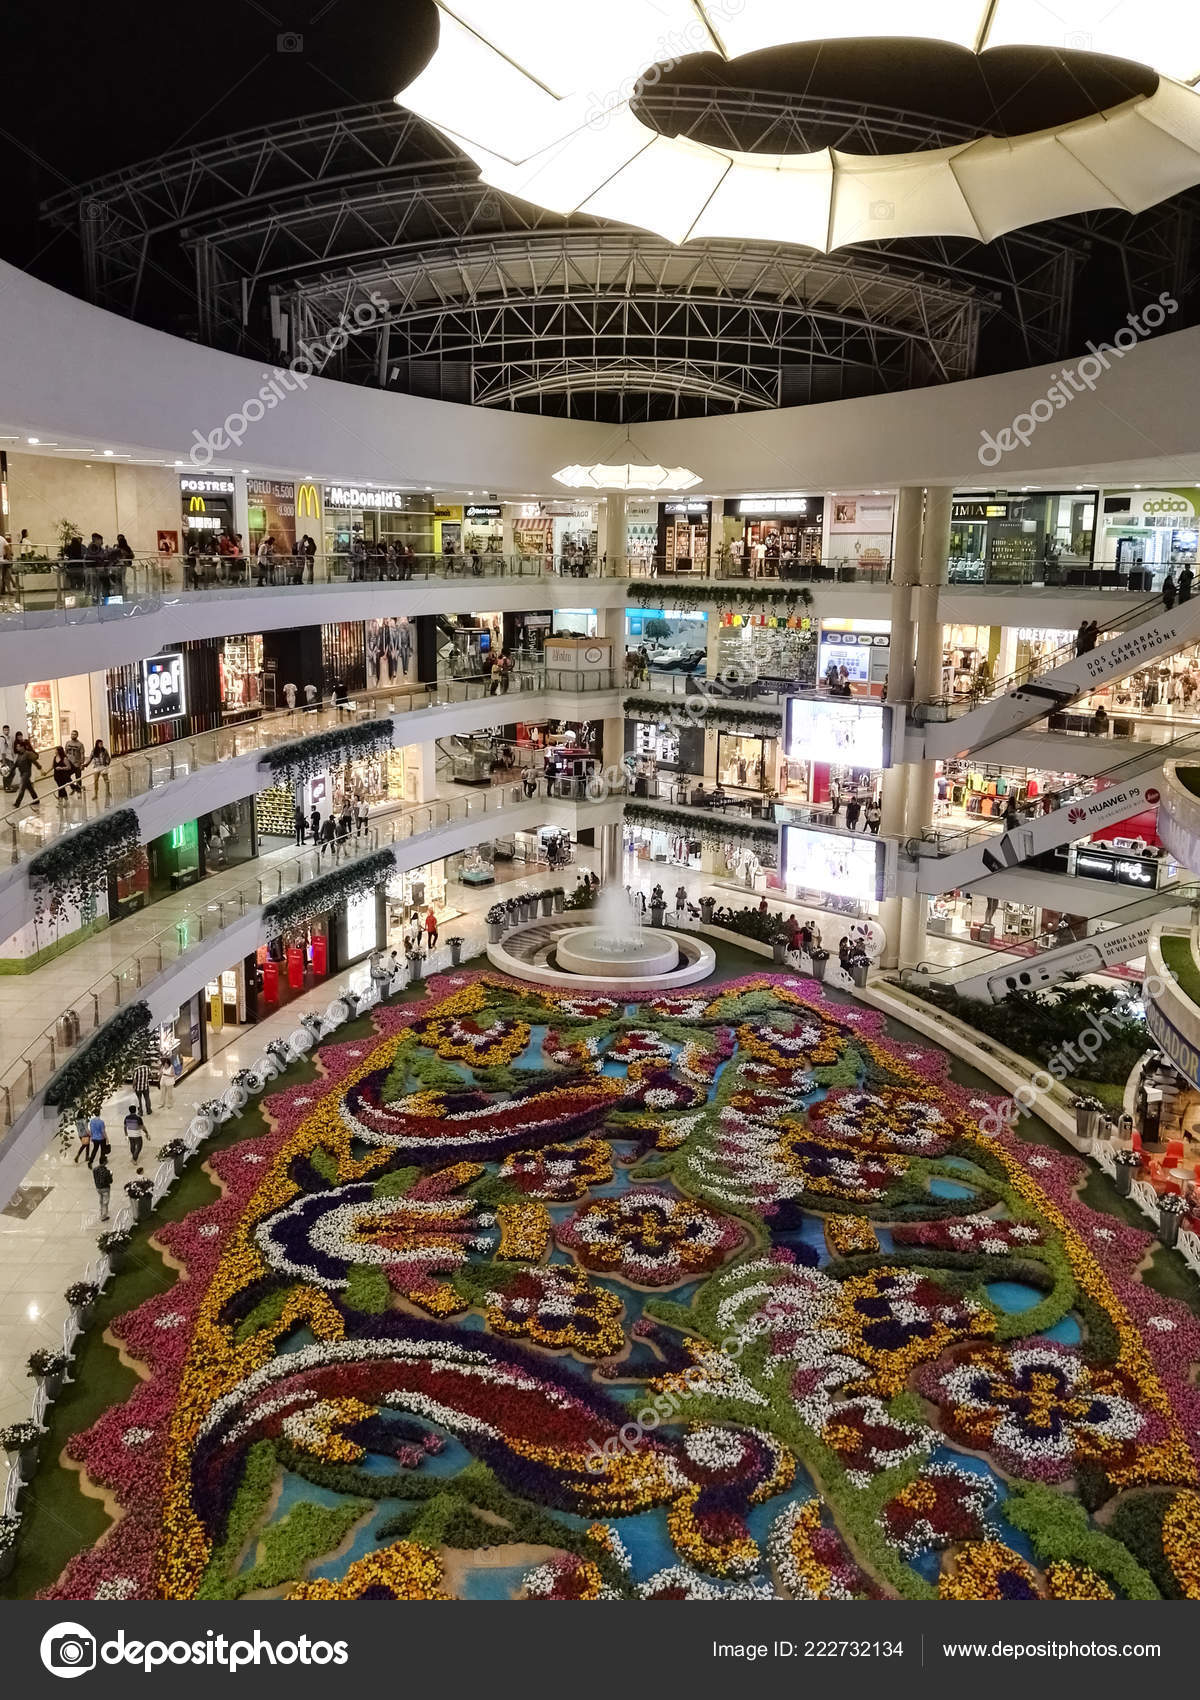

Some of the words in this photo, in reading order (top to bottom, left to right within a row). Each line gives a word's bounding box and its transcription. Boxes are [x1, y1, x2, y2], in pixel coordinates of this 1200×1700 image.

[181, 479, 235, 492] POSTRES
[330, 487, 402, 508] McDonald's
[1087, 656, 1107, 670] DOS
[1111, 628, 1160, 656] CAMARAS
[1090, 666, 1104, 677] UN
[1109, 629, 1177, 668] SMARTPHONE
[148, 659, 181, 705] gef
[1088, 794, 1128, 815] HUAWEI
[1129, 788, 1141, 799] P9
[1103, 936, 1128, 949] CAMBIA
[1128, 932, 1137, 941] LA
[1116, 943, 1129, 953] VER
[1129, 941, 1138, 950] EL
